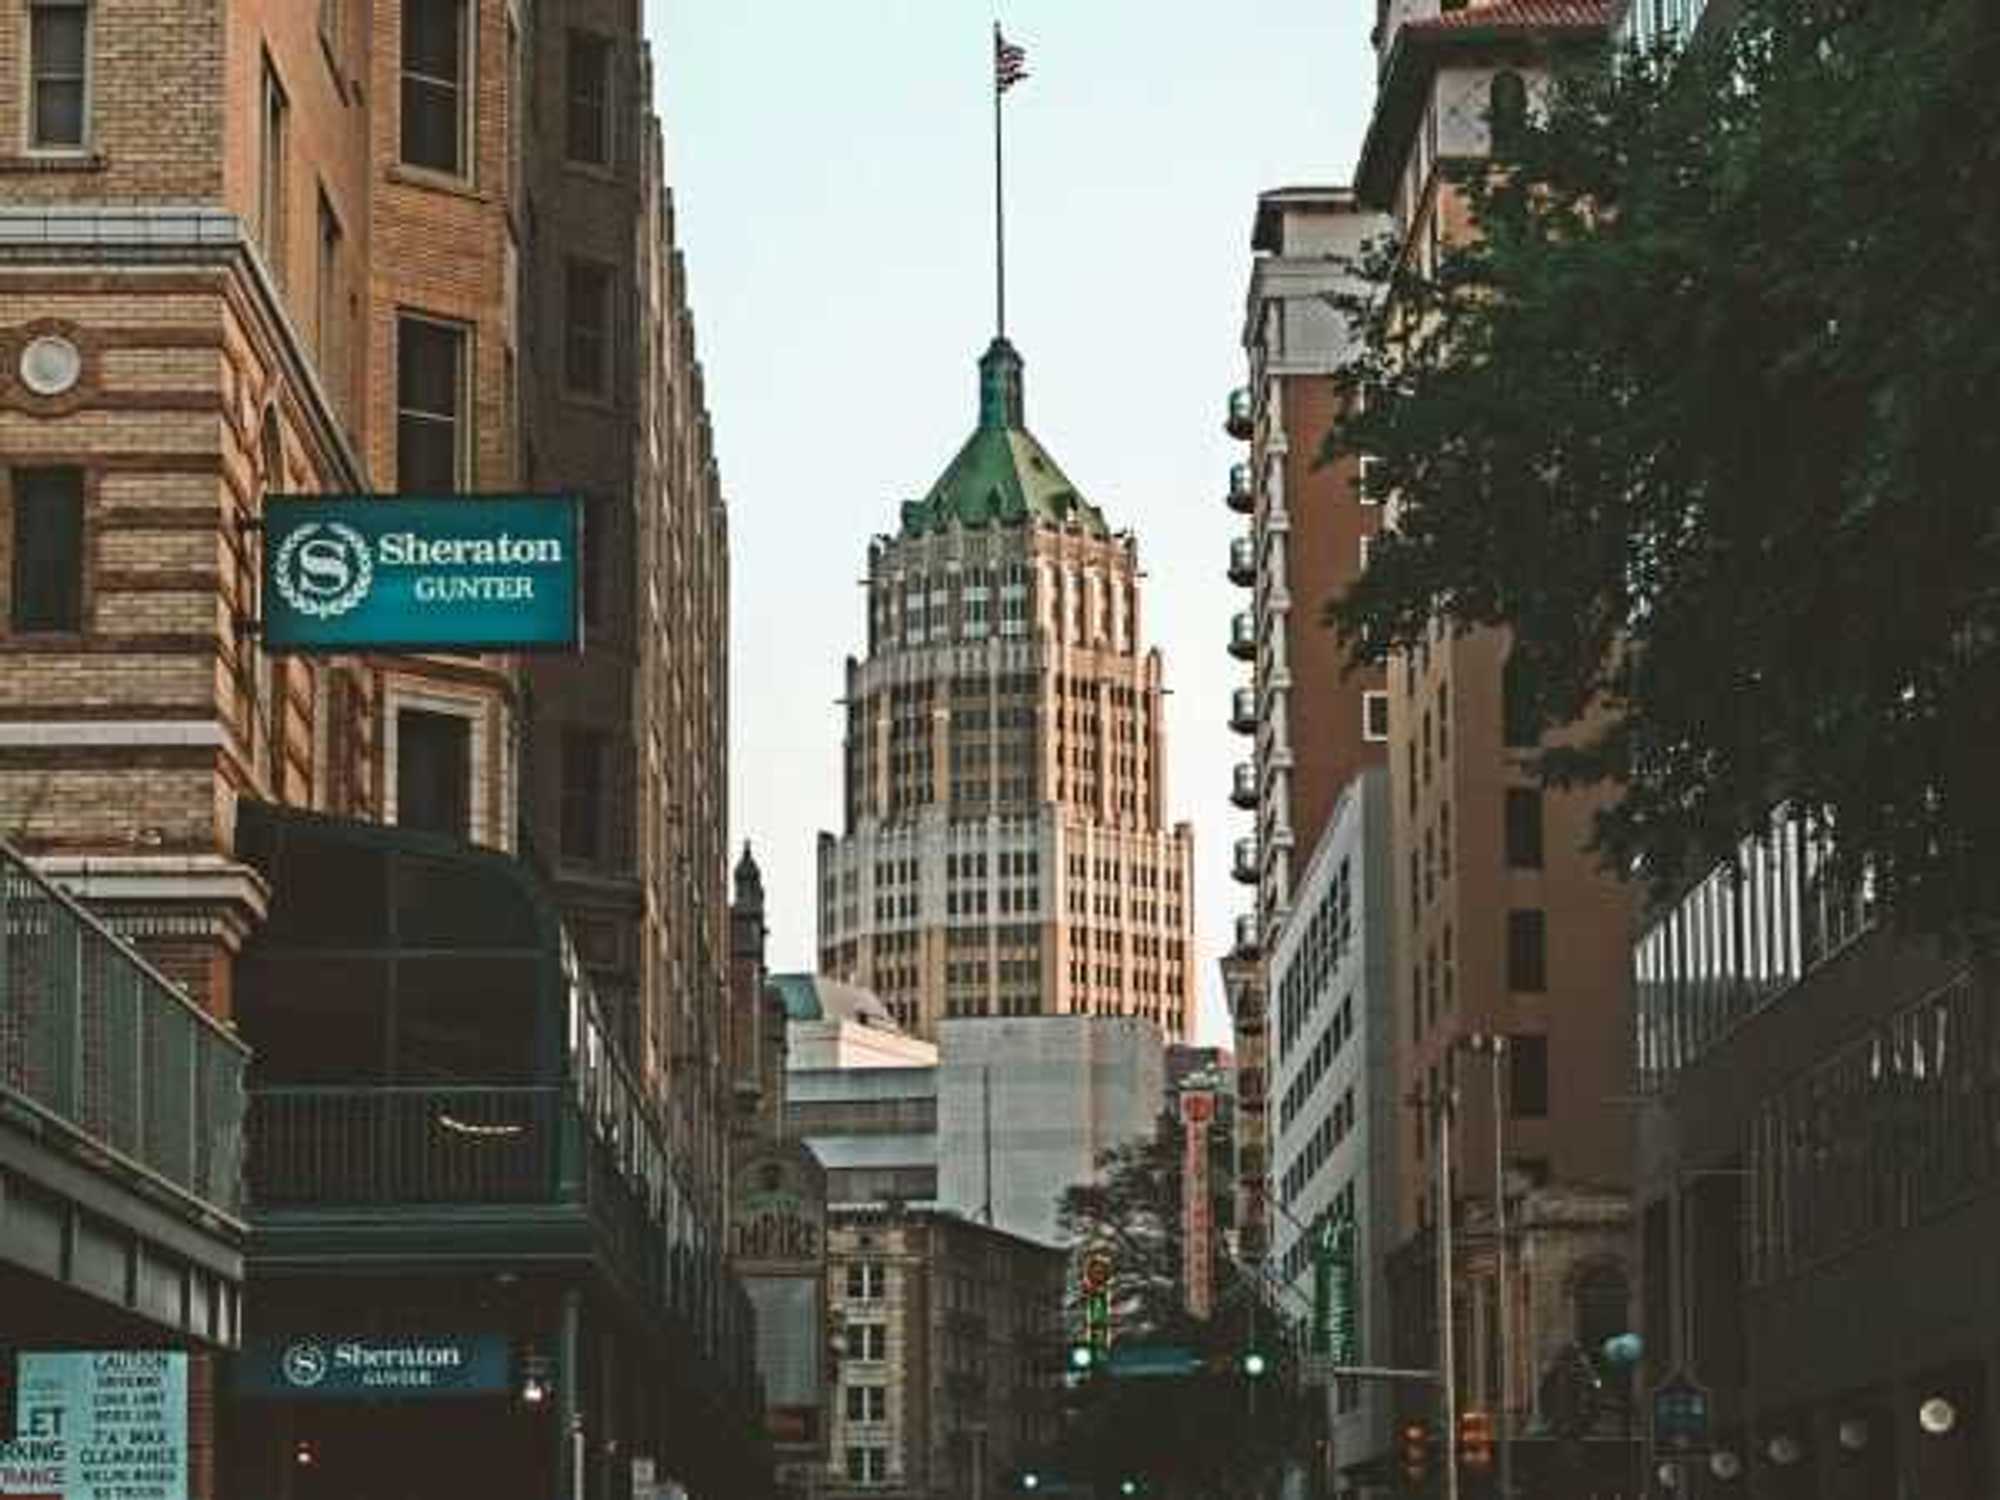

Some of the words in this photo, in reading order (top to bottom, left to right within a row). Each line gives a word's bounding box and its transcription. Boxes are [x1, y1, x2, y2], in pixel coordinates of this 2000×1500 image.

[378, 532, 562, 566] Sheraton
[299, 540, 349, 594] S
[414, 576, 535, 601] GUNTER
[334, 1343, 461, 1367] Sheraton
[80, 1447, 178, 1465] CLEARANCE
